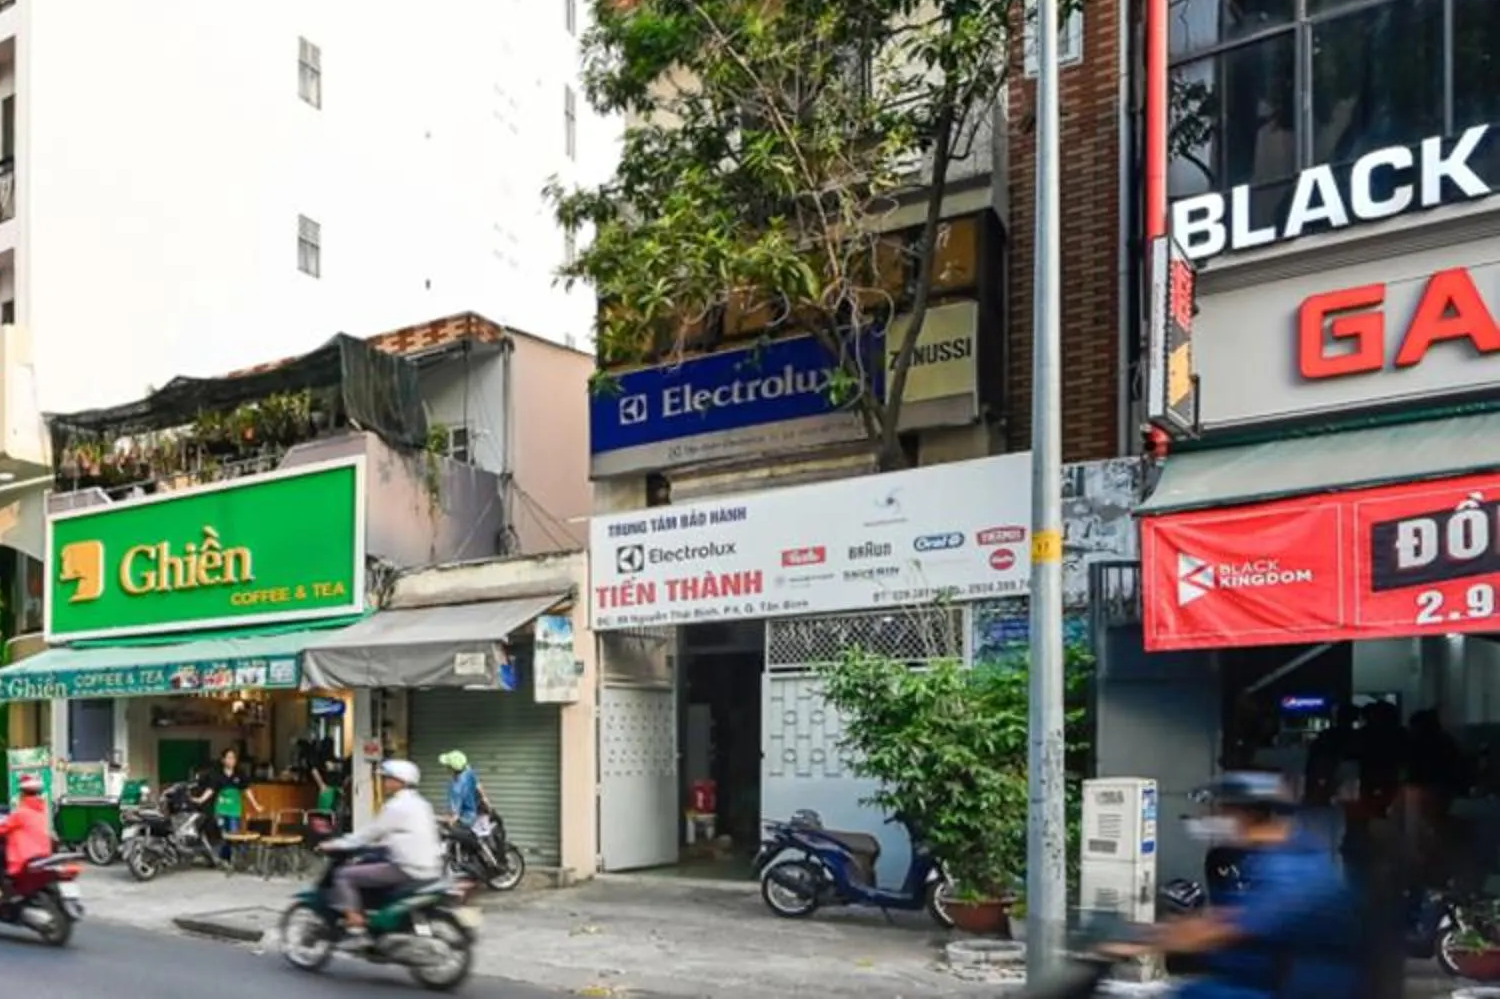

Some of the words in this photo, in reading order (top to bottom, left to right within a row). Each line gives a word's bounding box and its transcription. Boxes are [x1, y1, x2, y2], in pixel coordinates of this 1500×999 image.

[1171, 123, 1493, 260] BLACK
[1299, 266, 1500, 379] GA
[889, 337, 971, 371] ZNUSSI
[607, 520, 647, 538] TRUNG
[1395, 491, 1500, 570] ĐỒ
[119, 525, 255, 595] Ghiền
[650, 541, 737, 564] Electrolux
[1219, 558, 1279, 576] BLACK
[231, 588, 290, 606] COFFEE
[312, 582, 345, 598] TEA
[665, 569, 763, 602] THÀNH
[1219, 568, 1313, 588] KINGDOM
[1415, 583, 1495, 625] 2.9
[74, 673, 122, 688] COFFEE
[140, 670, 164, 684] TEA
